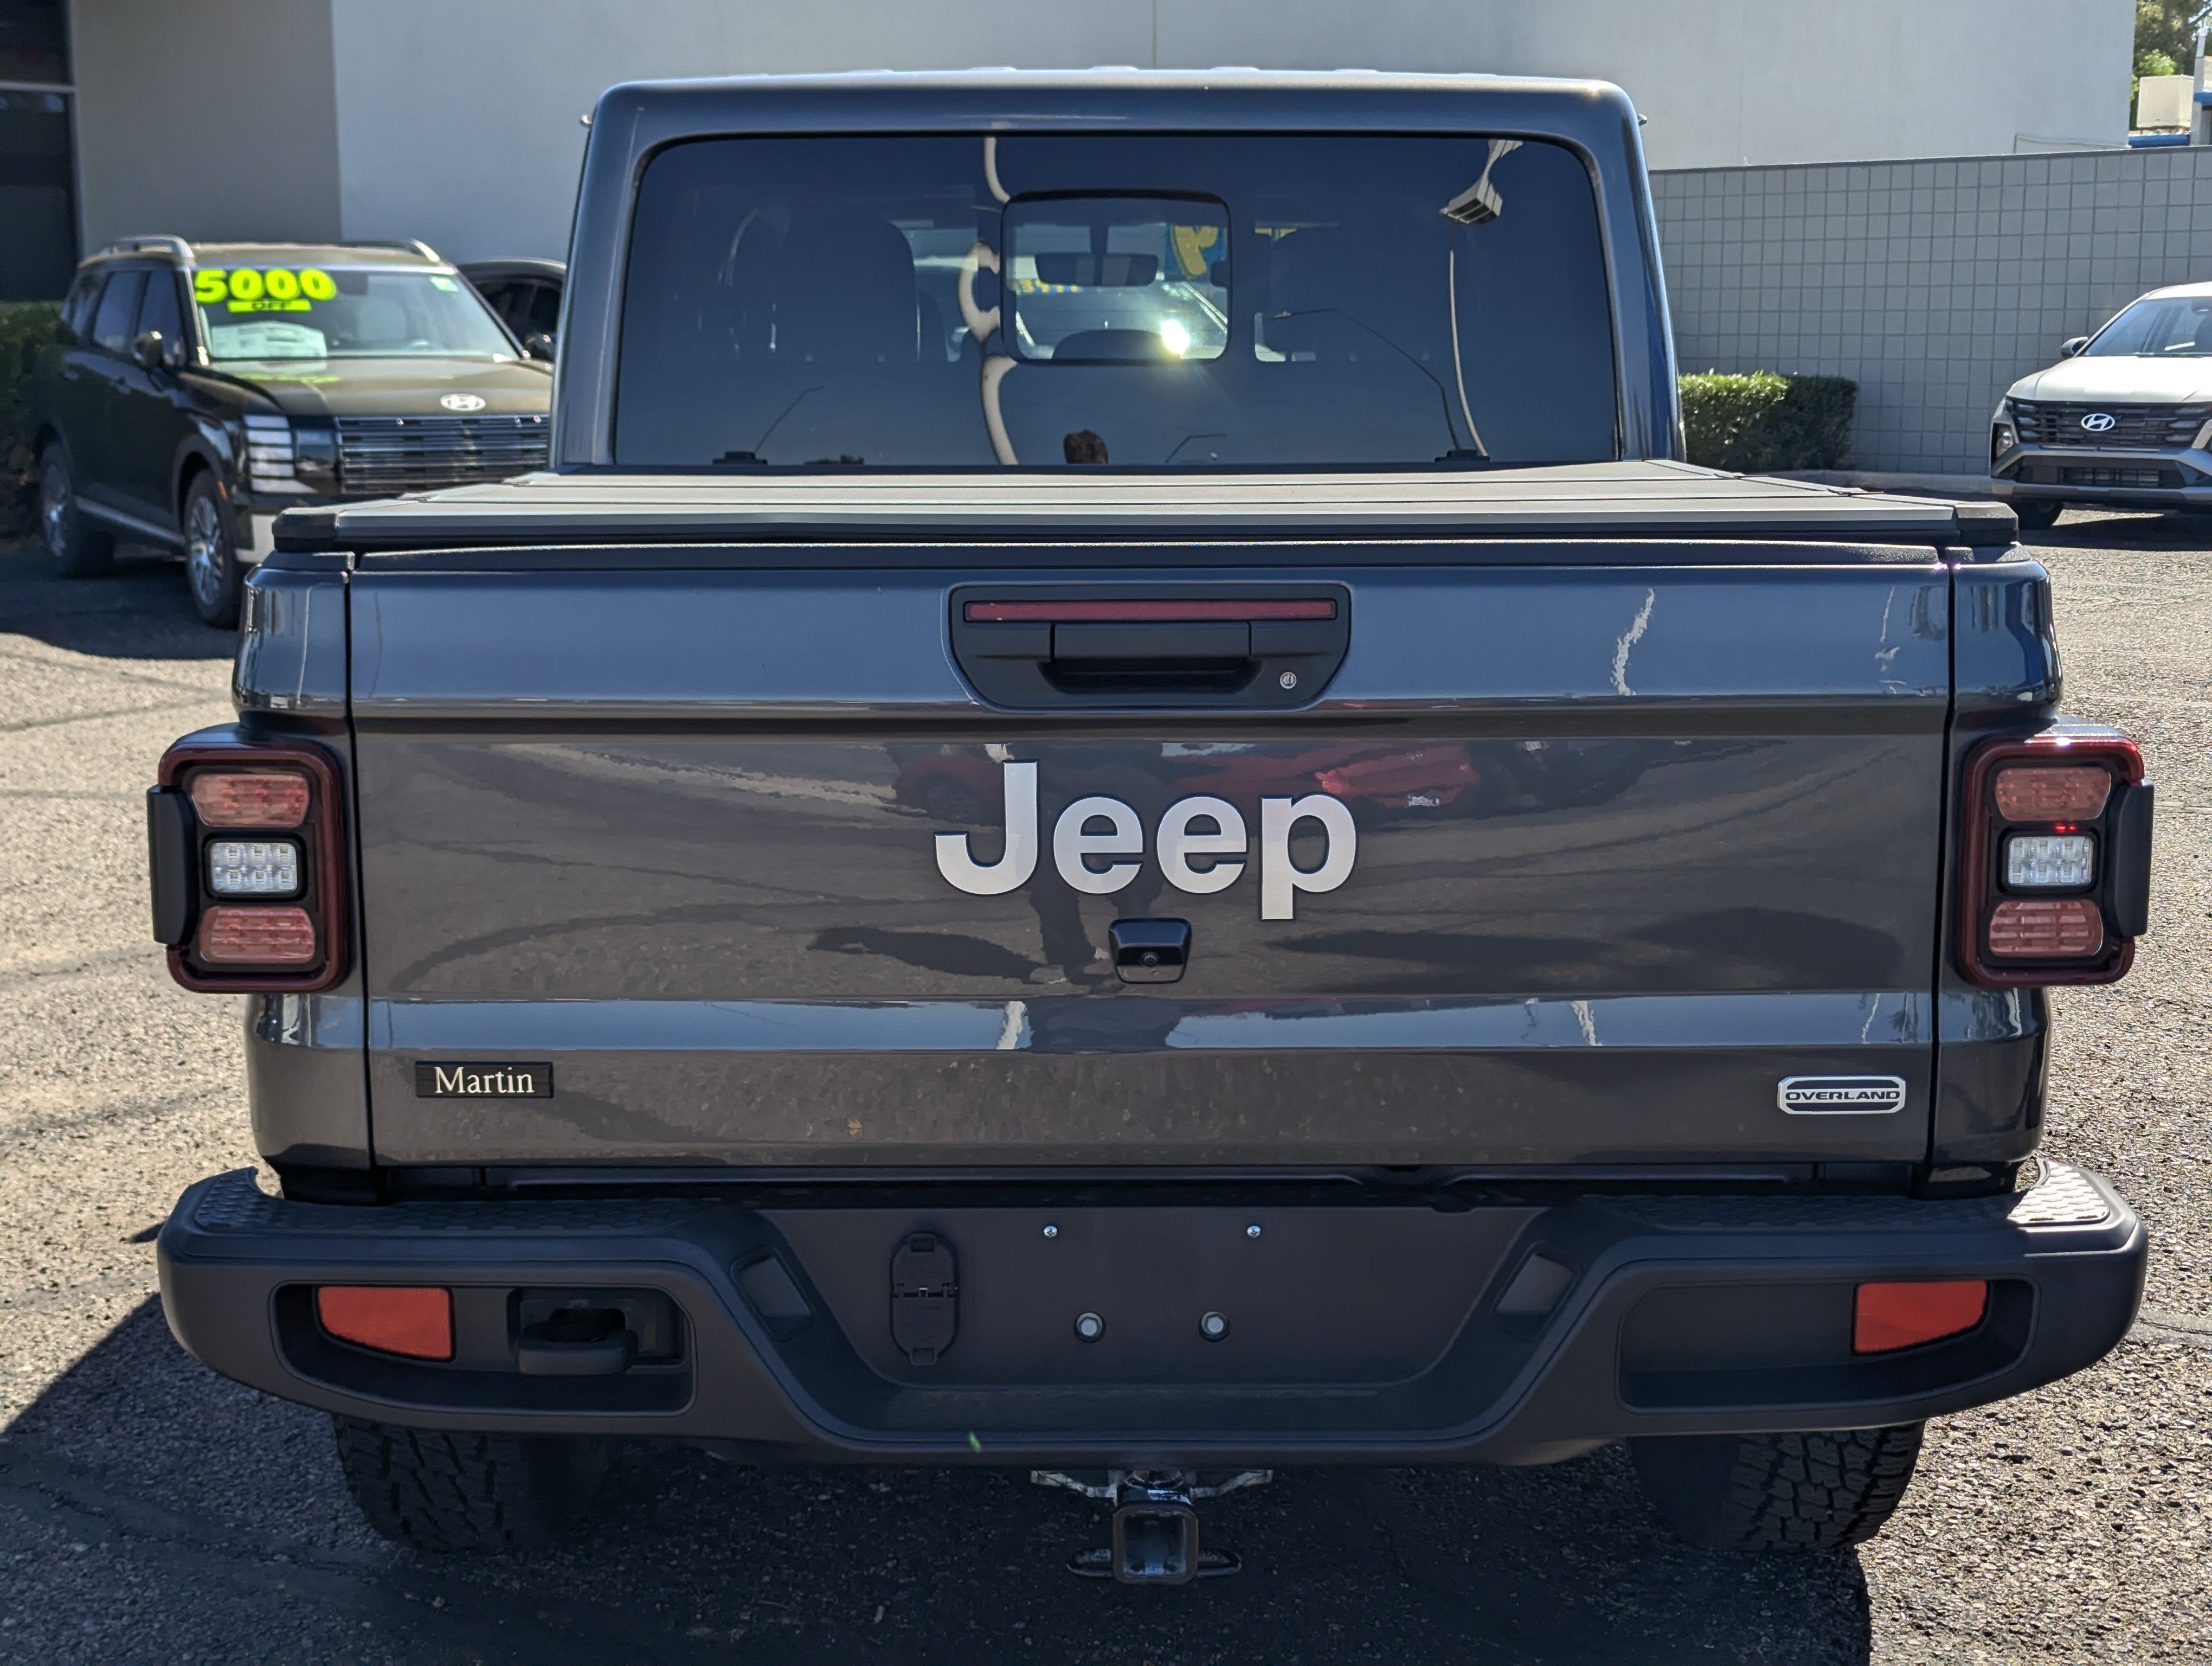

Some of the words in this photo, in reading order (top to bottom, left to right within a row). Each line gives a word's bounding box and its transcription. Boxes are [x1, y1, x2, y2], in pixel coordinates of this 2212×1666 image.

[194, 267, 337, 303] 5000
[934, 759, 1357, 920] Jeep
[434, 1066, 535, 1093] Martin
[1785, 1091, 1900, 1100] OVERLAND
